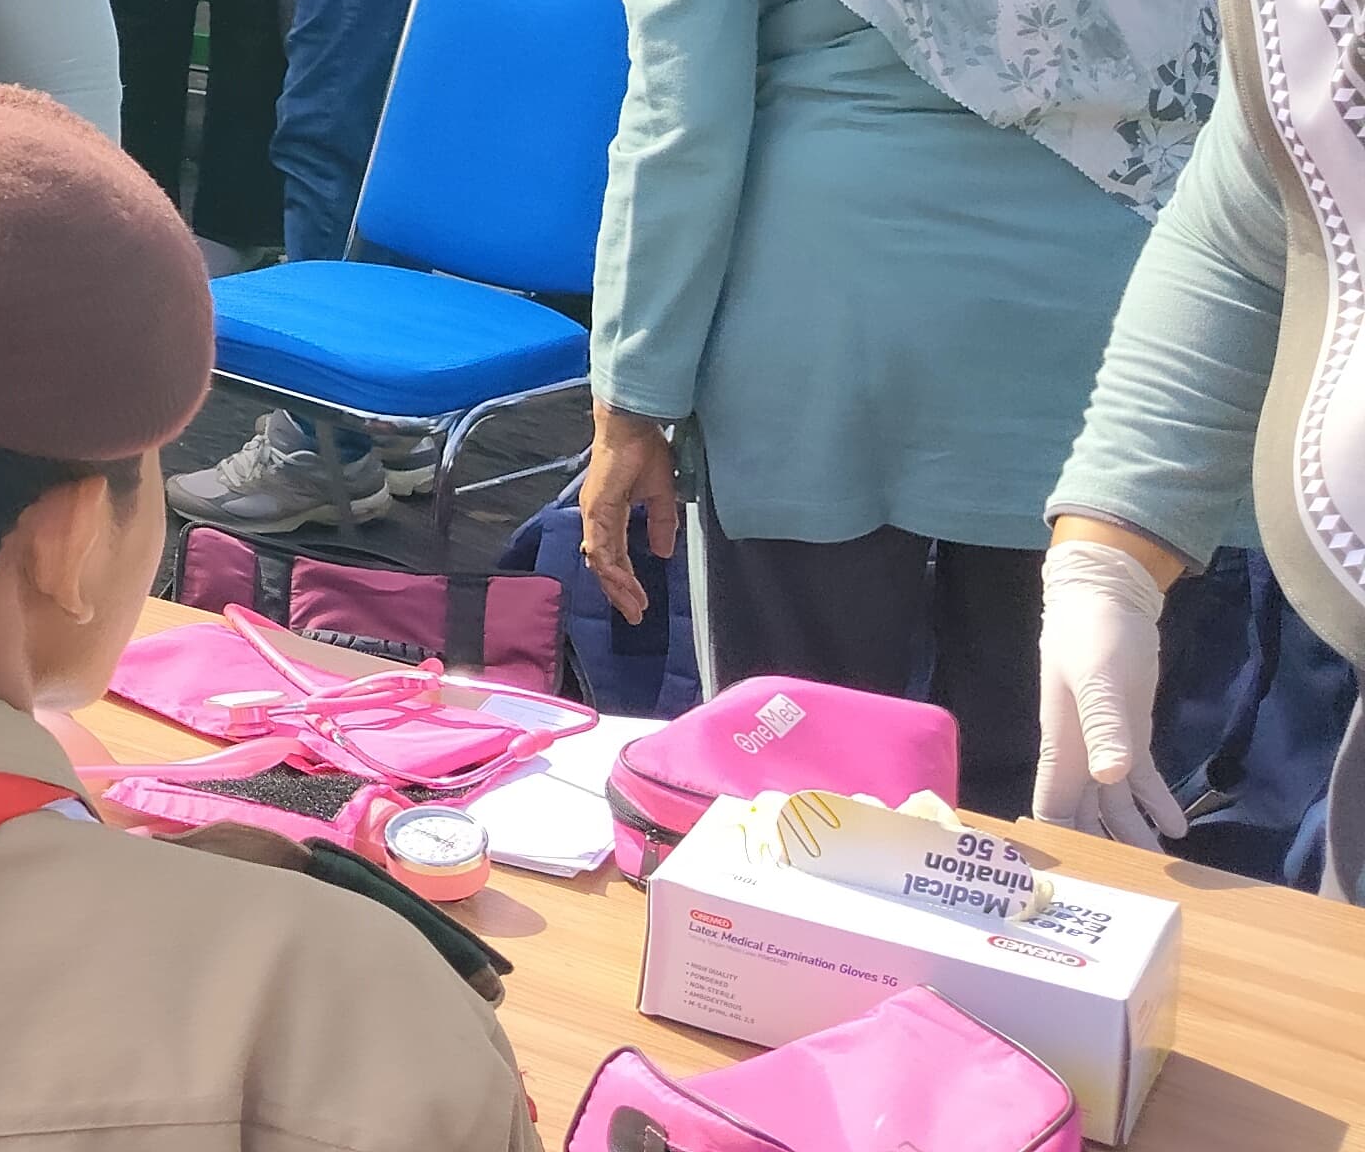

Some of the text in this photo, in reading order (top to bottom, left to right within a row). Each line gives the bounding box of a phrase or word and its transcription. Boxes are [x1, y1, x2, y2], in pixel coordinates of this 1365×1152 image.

[956, 833, 995, 862] 5G
[903, 872, 1010, 918] Medical
[692, 910, 730, 928] ONEMED
[689, 921, 719, 939] Latex
[721, 931, 764, 951] Medical
[766, 944, 836, 972] Examination
[839, 964, 878, 983] Gloves
[882, 975, 898, 987] 5G
[992, 936, 1080, 967] ONEMED
[690, 972, 729, 988] POWDERED
[708, 967, 738, 981] QUALITY
[689, 991, 742, 1011] AMBIDEXTROUS
